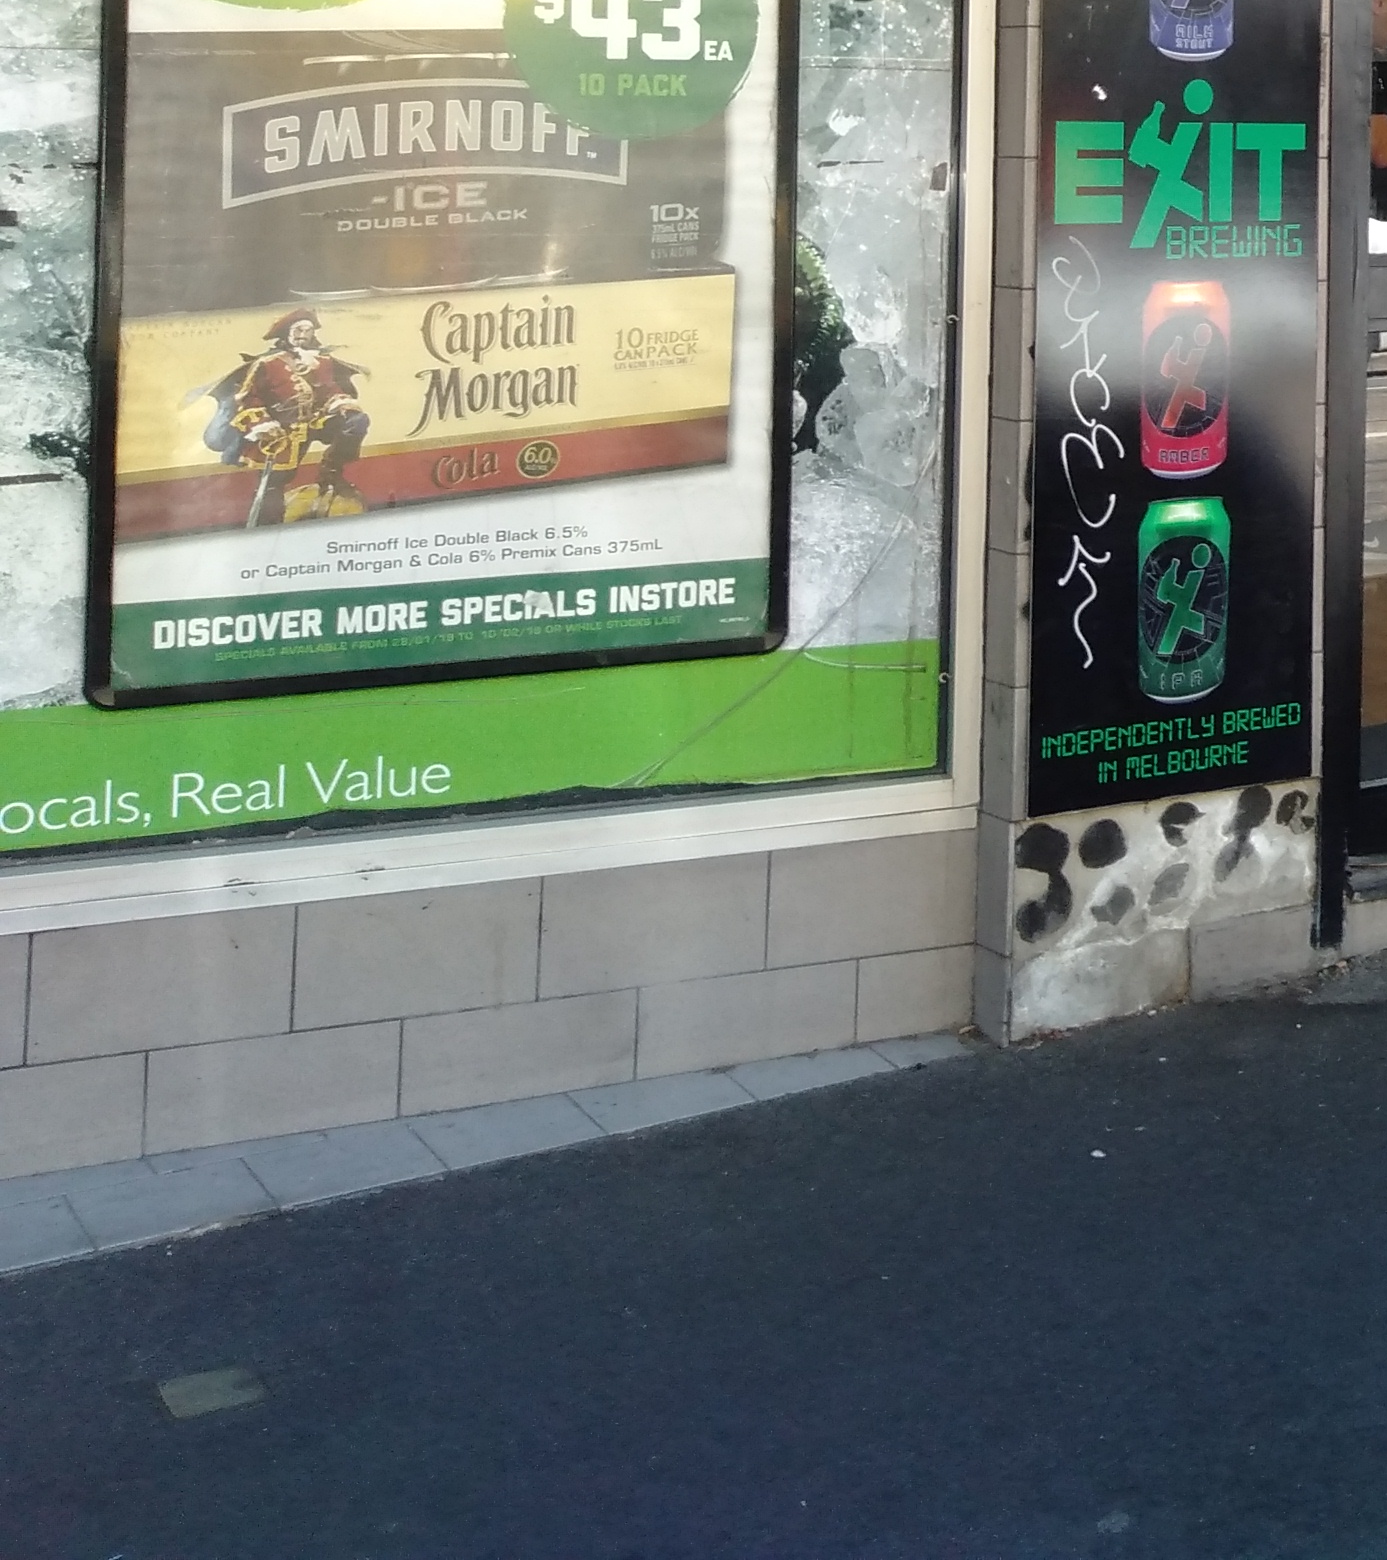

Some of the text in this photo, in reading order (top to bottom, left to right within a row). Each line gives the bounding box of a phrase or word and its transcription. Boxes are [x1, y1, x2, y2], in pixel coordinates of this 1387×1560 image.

[704, 40, 733, 63] EA
[578, 74, 687, 97] 10 PACK
[1054, 79, 1306, 249] EXIT
[337, 208, 527, 233] DOUBLE BLACK
[650, 203, 699, 222] 10x
[1166, 223, 1302, 260] BREWING
[421, 294, 575, 365] Captain
[615, 327, 699, 349] 10 FRIDGE
[614, 342, 697, 361] CAN PACK
[406, 363, 580, 438] Morgan
[431, 448, 501, 490] Cola
[240, 538, 663, 580] or Captain Morgan & Cola 6% Premix Cans 375mL
[327, 525, 588, 555] Smirnoff Ice Double Black 6.5%
[153, 608, 322, 650] DISCOVER
[337, 601, 428, 635] MORE
[441, 589, 597, 626] SPECIALS
[609, 578, 736, 613] INSTORE
[1160, 669, 1203, 692] IPA
[1041, 701, 1301, 759] INDEPENDENTLY BREWED
[1097, 746, 1250, 785] IN MELBOURNE
[171, 764, 285, 819] Real
[306, 756, 451, 804] Value
